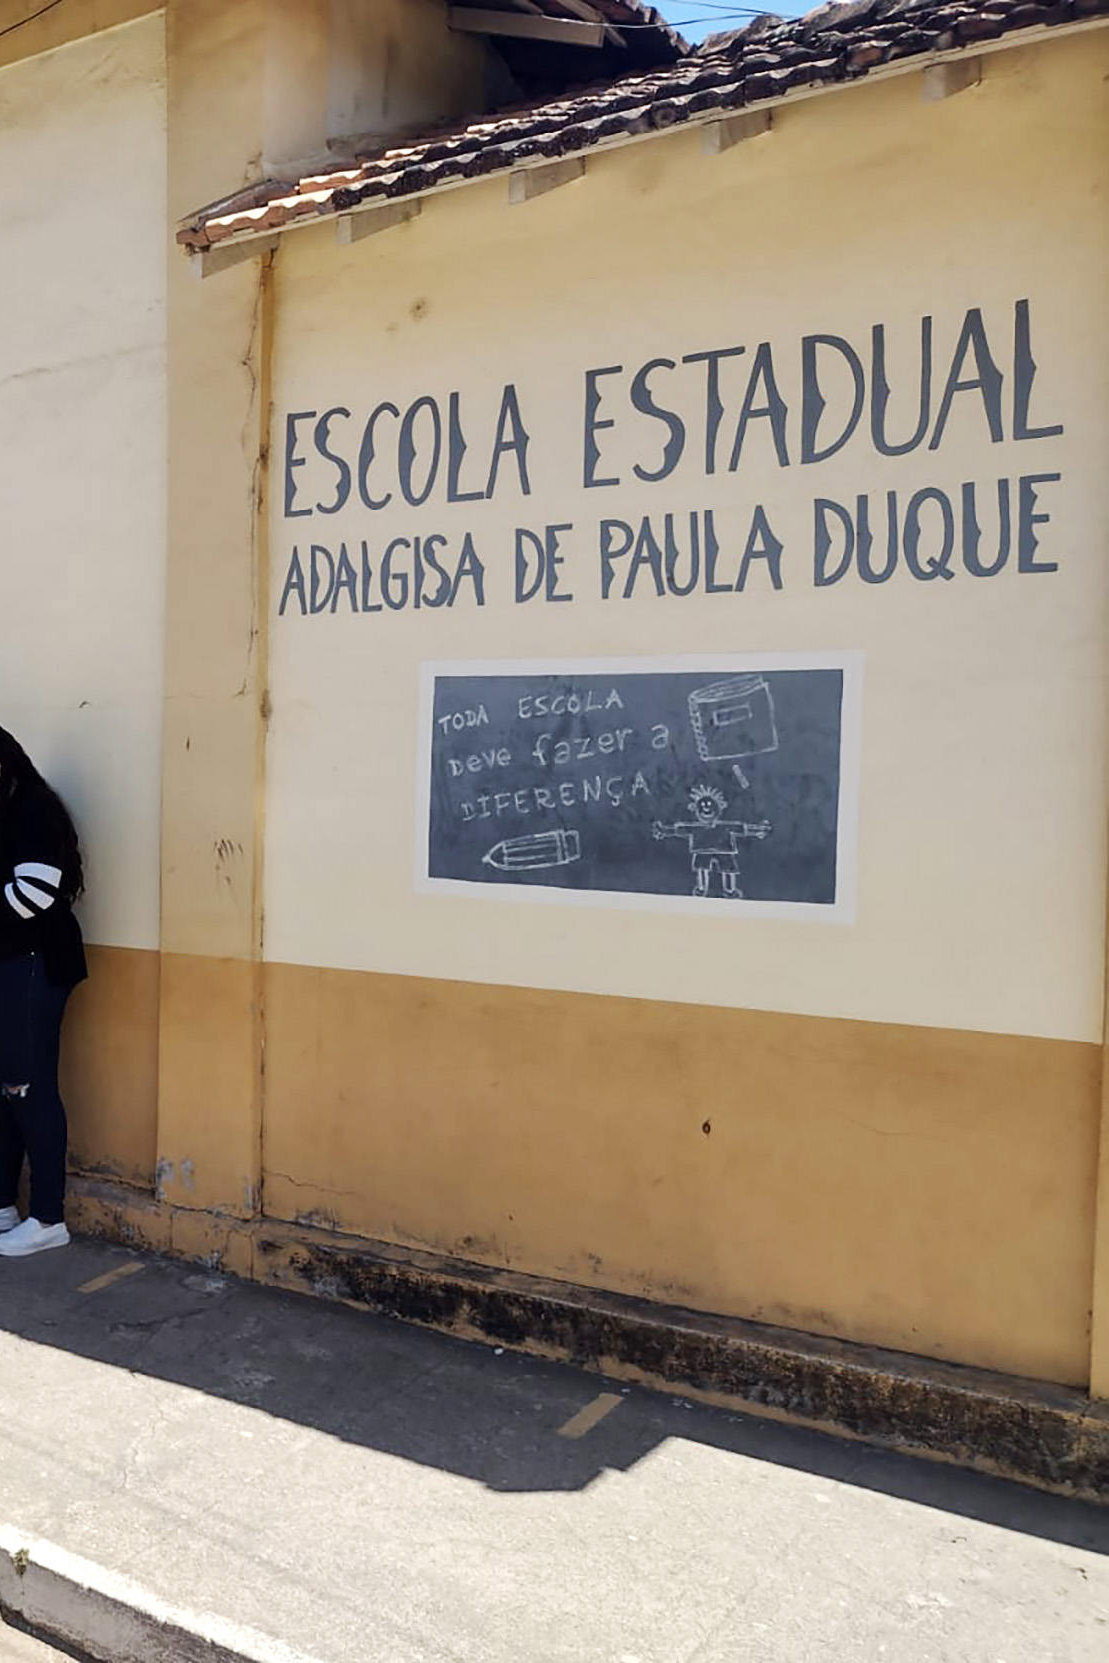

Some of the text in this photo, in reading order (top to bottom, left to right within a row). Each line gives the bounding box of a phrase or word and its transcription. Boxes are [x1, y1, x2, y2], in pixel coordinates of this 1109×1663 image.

[283, 298, 1064, 518] ESCOLA ESTADUAL
[278, 472, 1062, 616] ADALGISA DE PAULA DUQUE
[437, 688, 625, 735] TODA ESCOLA
[531, 727, 633, 766] fazer
[650, 723, 670, 749] a
[460, 770, 652, 822] DIFERENÇA
